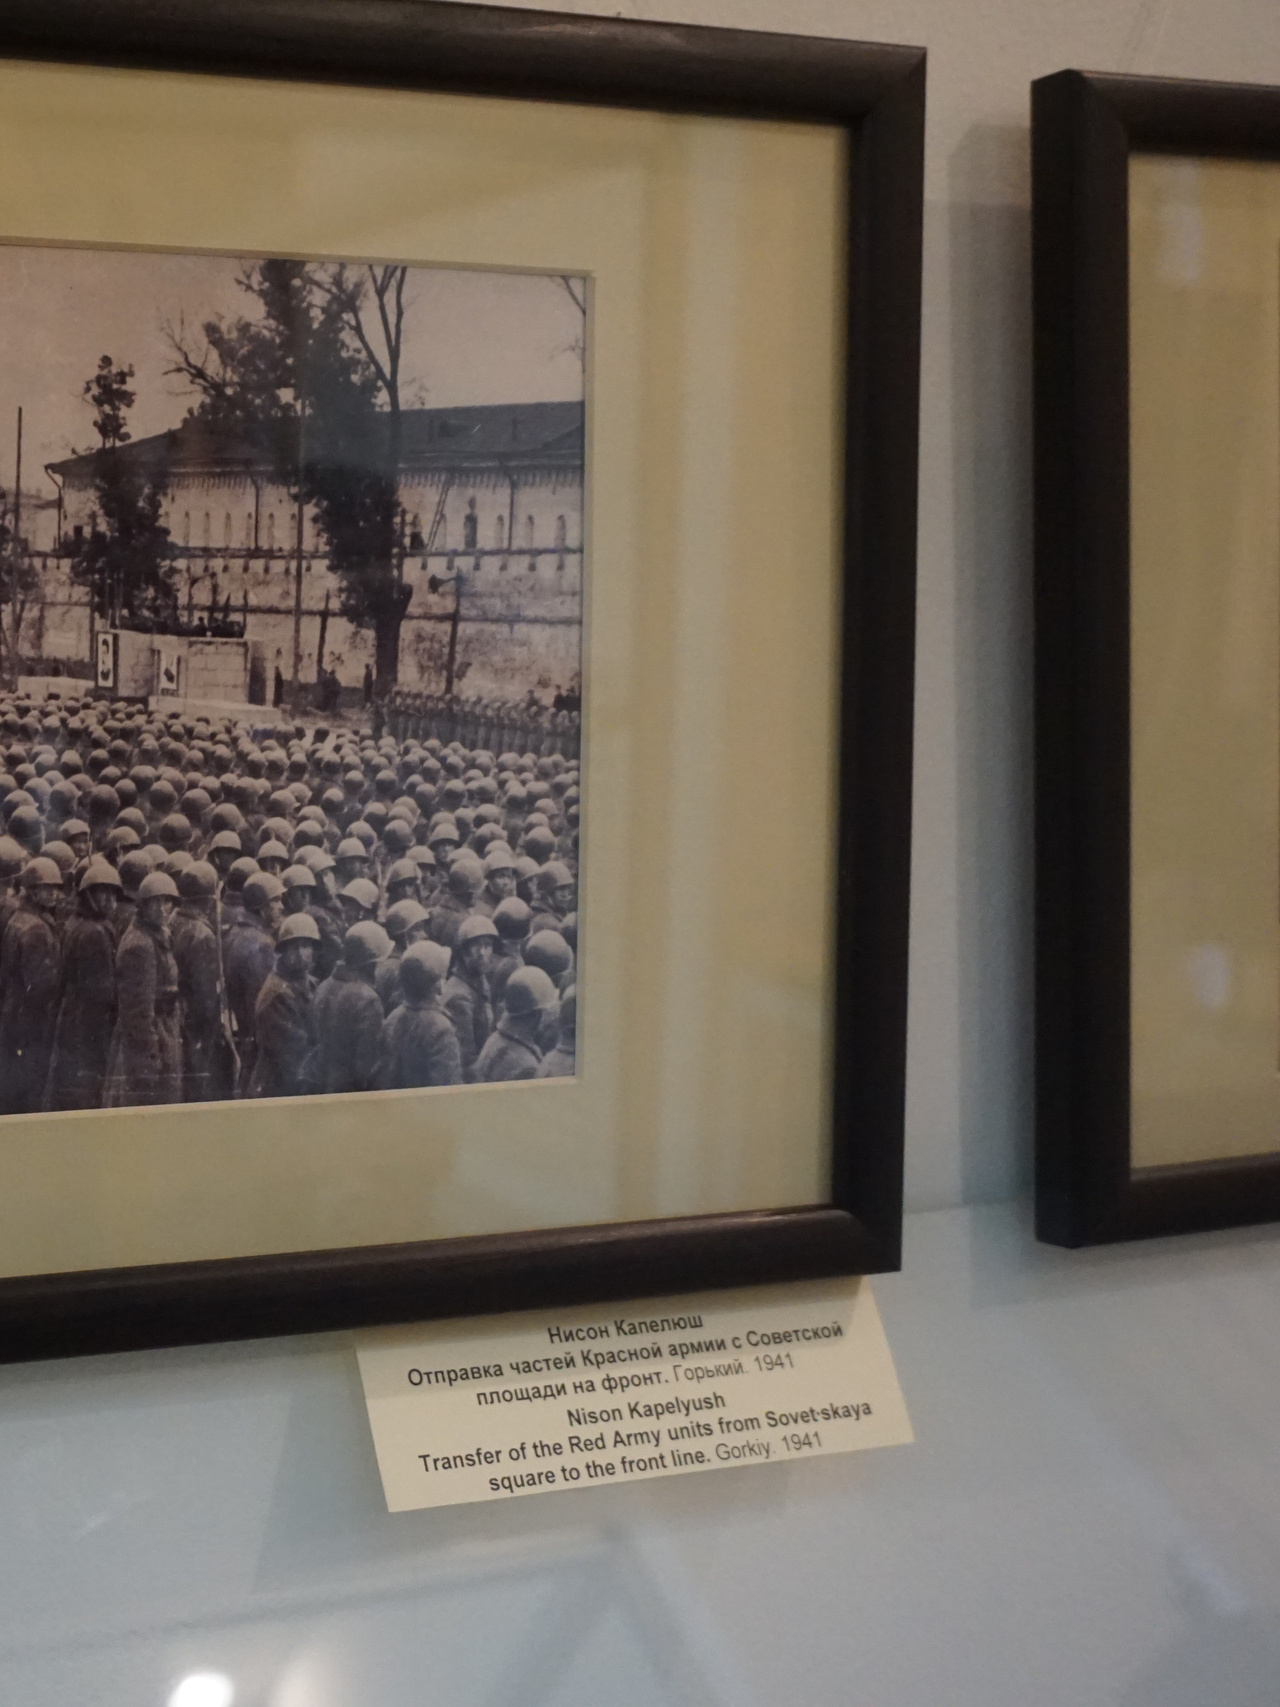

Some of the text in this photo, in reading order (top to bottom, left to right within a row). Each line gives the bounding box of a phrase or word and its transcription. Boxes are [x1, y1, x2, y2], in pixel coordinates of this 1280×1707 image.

[408, 1321, 844, 1388] Отправка частей Красной армии с Советской
[547, 1314, 704, 1346] Нисон Капелюш
[475, 1352, 796, 1407] площади на фронт. Горький. 1941
[566, 1392, 726, 1428] Nison Kapelyush
[418, 1447, 503, 1473] Transfer
[508, 1442, 527, 1461] of
[531, 1439, 563, 1458] the
[567, 1431, 607, 1454] Red
[612, 1427, 662, 1450] Army
[668, 1420, 714, 1441] units
[718, 1415, 762, 1434] from
[488, 1431, 823, 1494] square to the front line. Gorkiy. 1941
